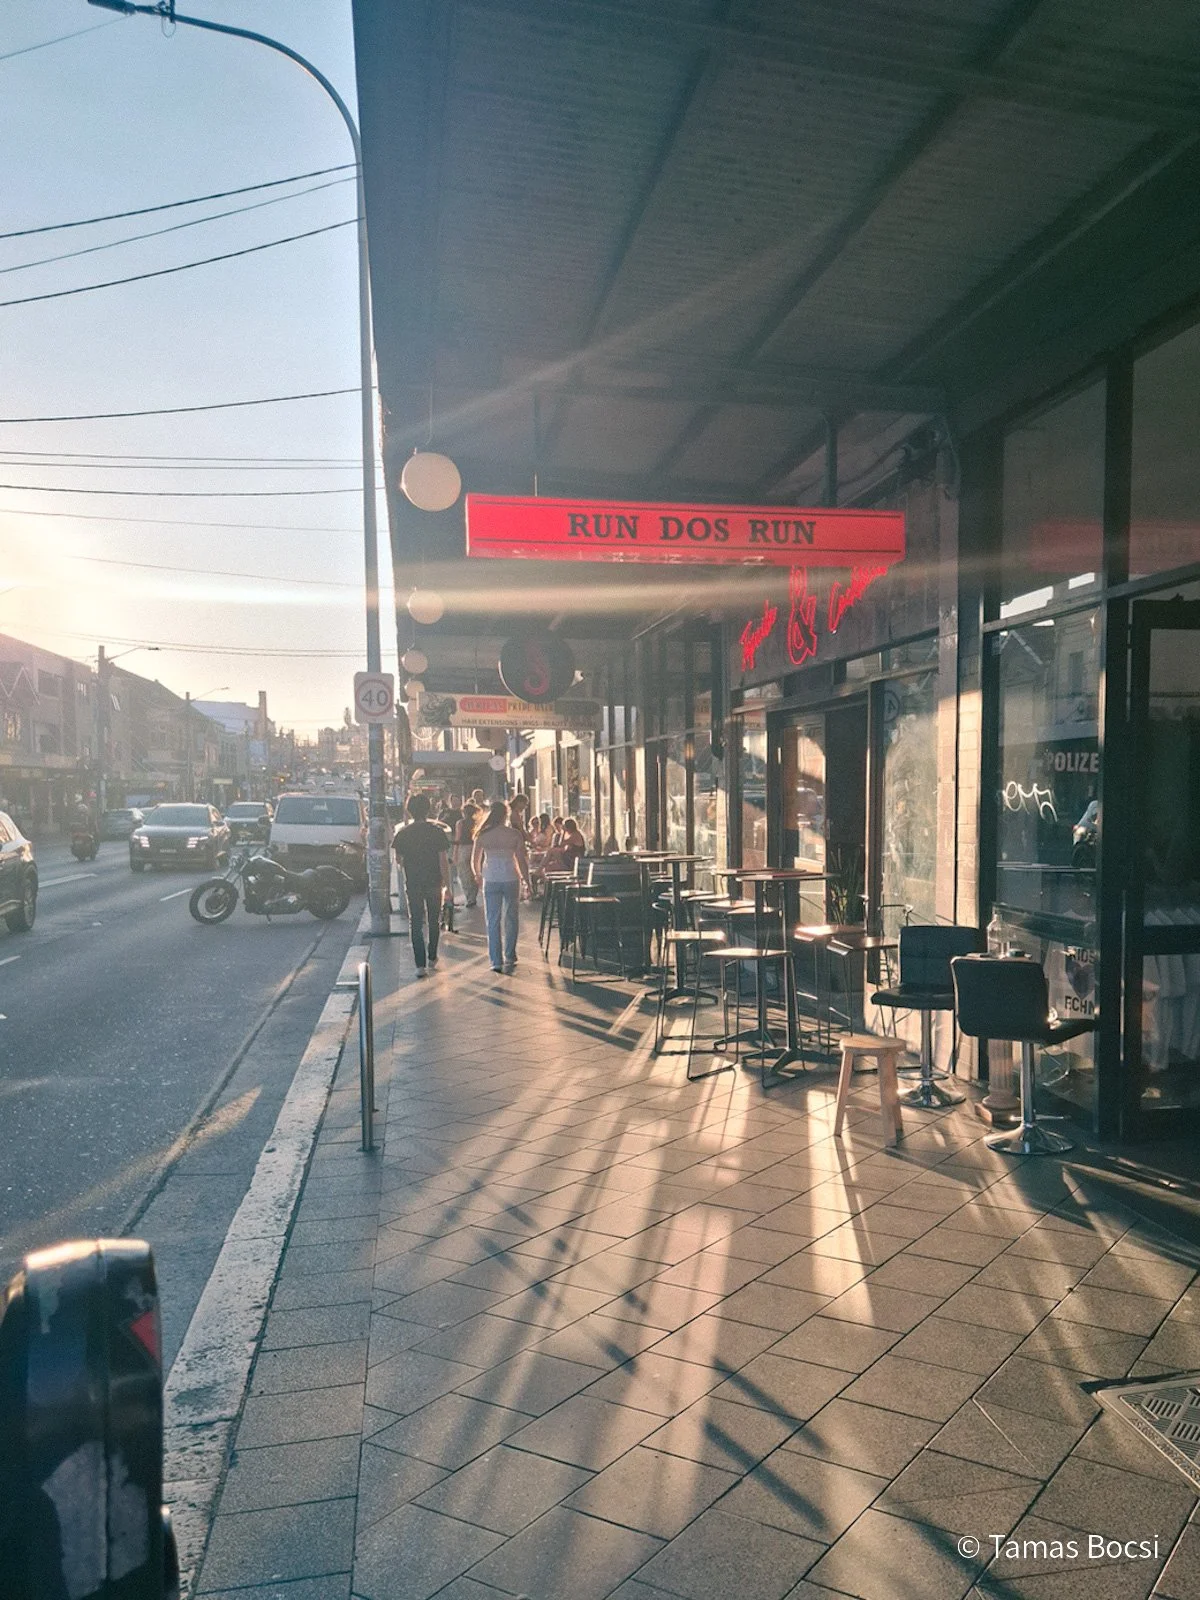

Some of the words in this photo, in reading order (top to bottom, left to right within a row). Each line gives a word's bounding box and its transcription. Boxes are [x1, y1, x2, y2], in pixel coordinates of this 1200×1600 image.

[566, 512, 639, 540] RUN
[659, 515, 730, 543] DOS
[748, 518, 817, 545] RUN
[361, 689, 389, 707] 40
[461, 718, 477, 726] HAIR
[478, 719, 518, 727] EXTENSIONS
[522, 719, 539, 727] WIGS
